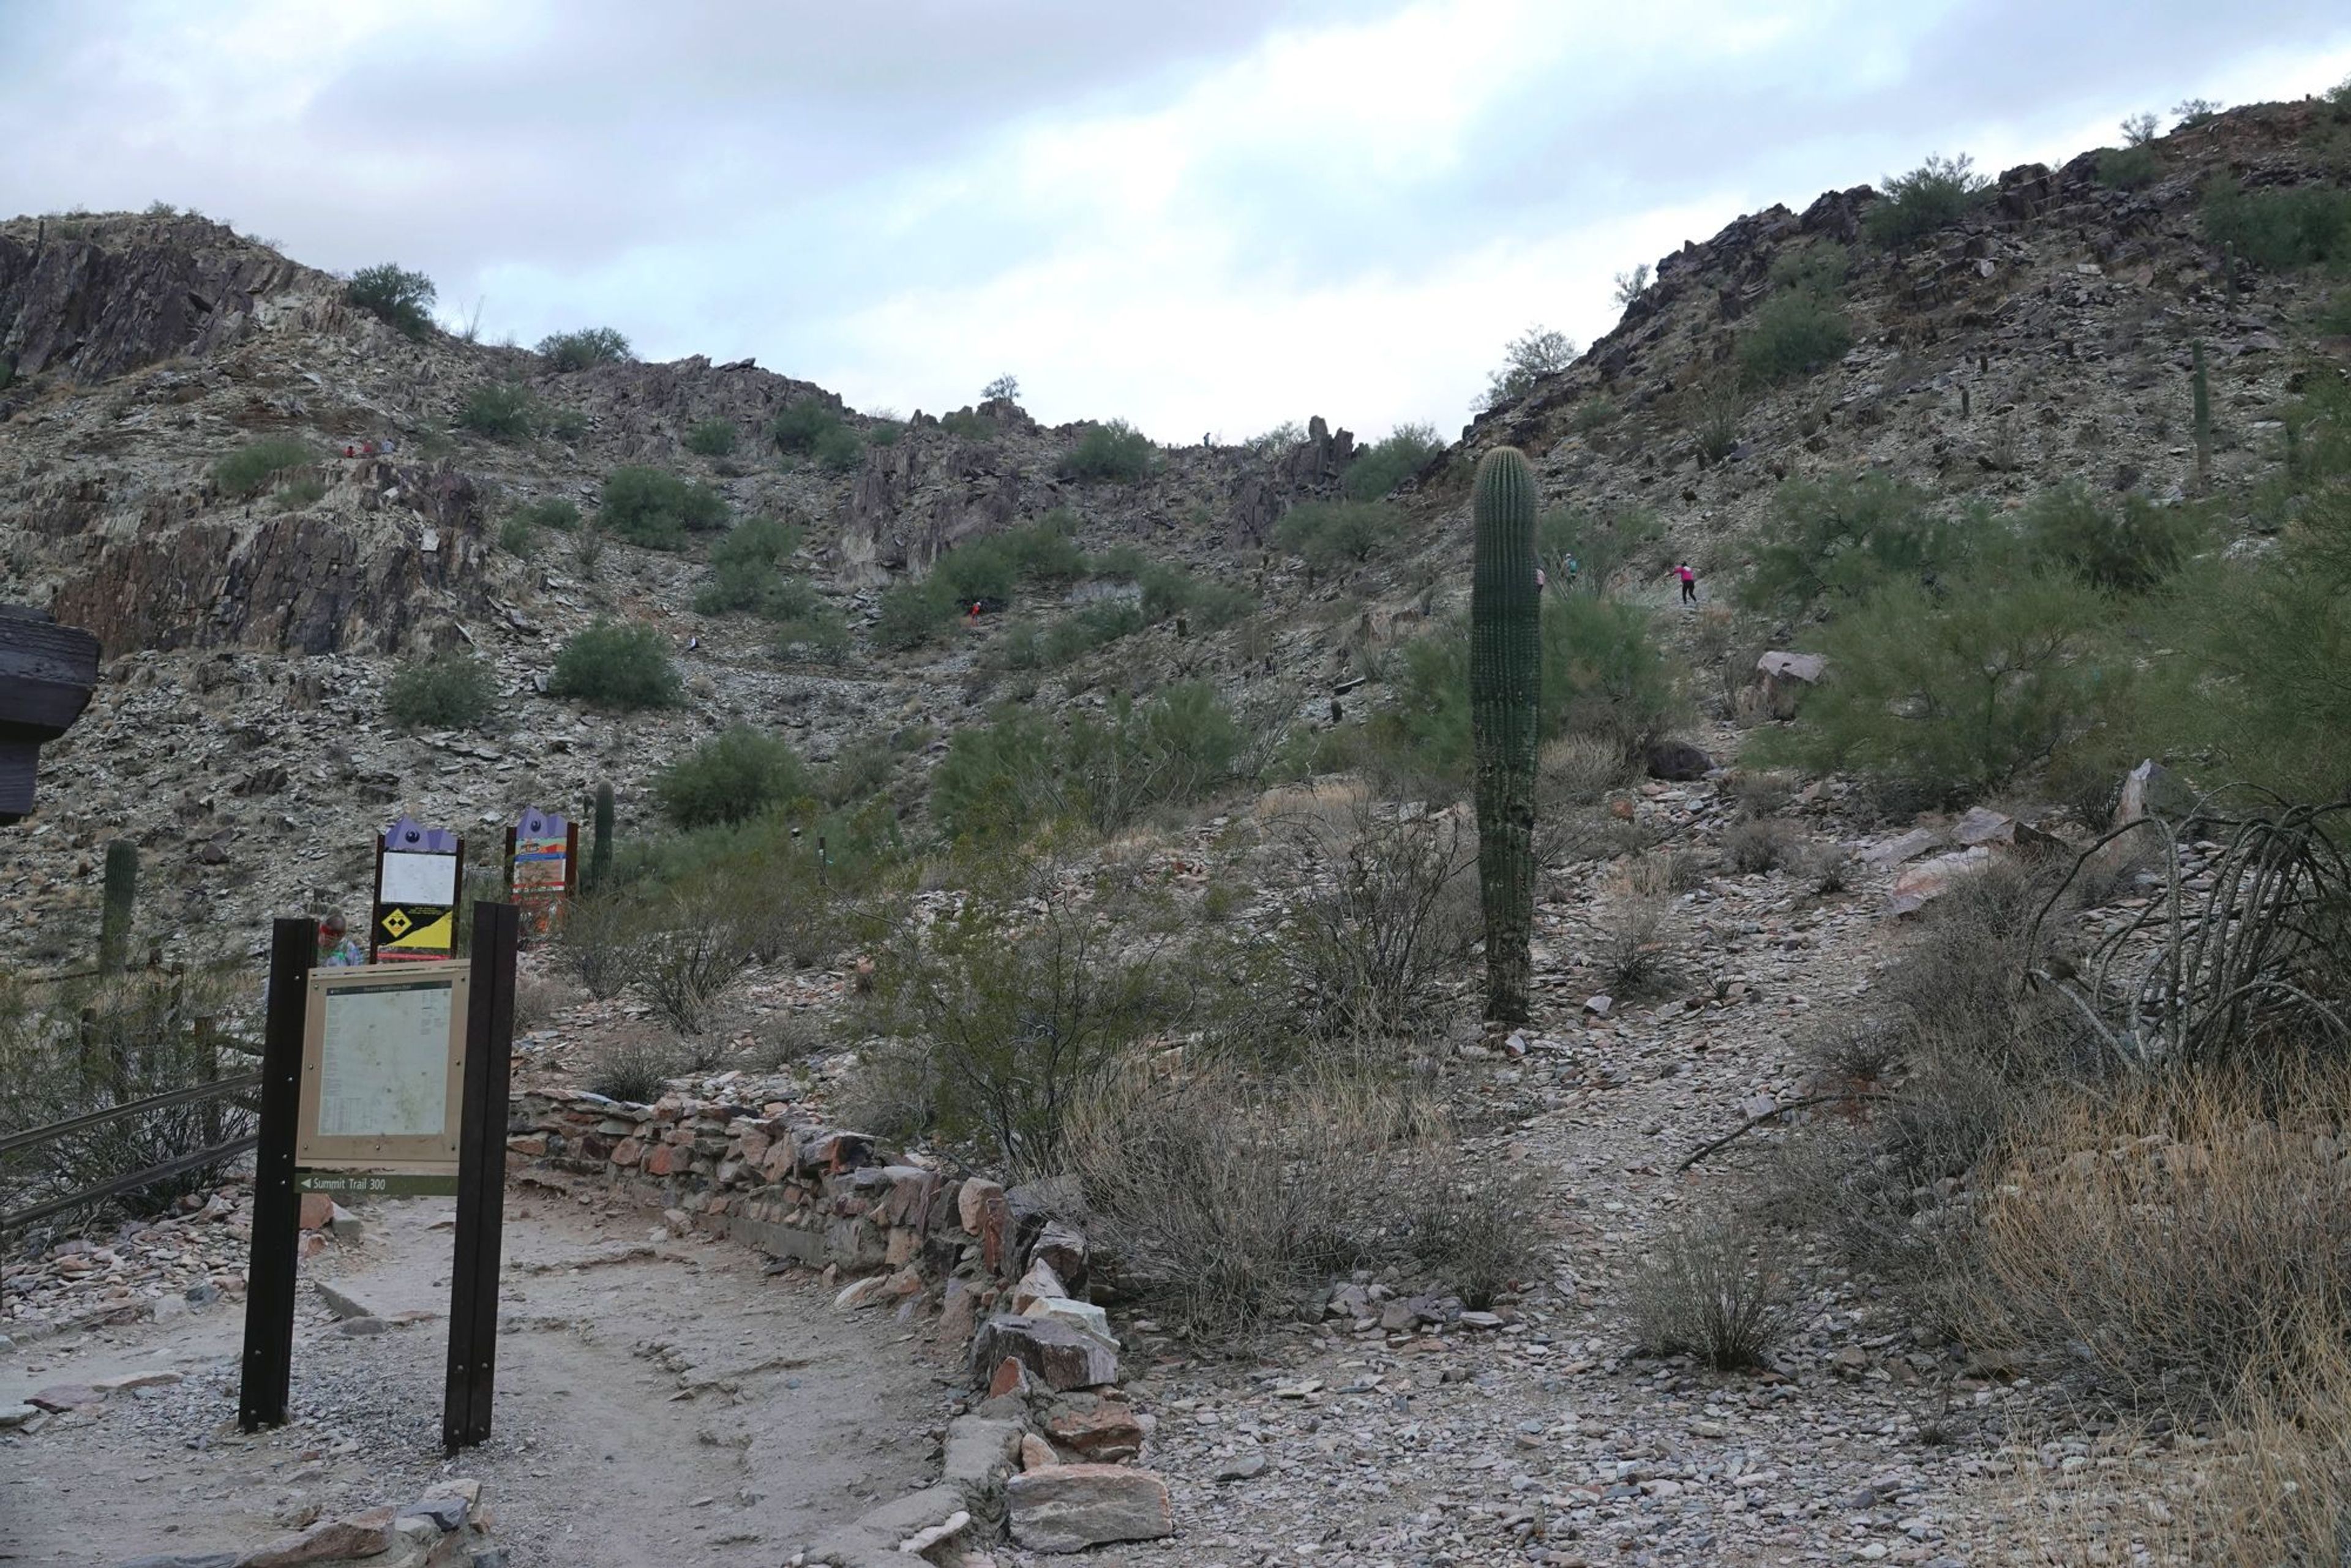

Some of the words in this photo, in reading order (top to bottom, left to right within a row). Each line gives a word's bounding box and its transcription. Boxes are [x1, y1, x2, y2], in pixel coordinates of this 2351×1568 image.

[313, 1177, 345, 1189] Summit
[348, 1177, 367, 1189] Trail
[370, 1179, 386, 1190] 300
